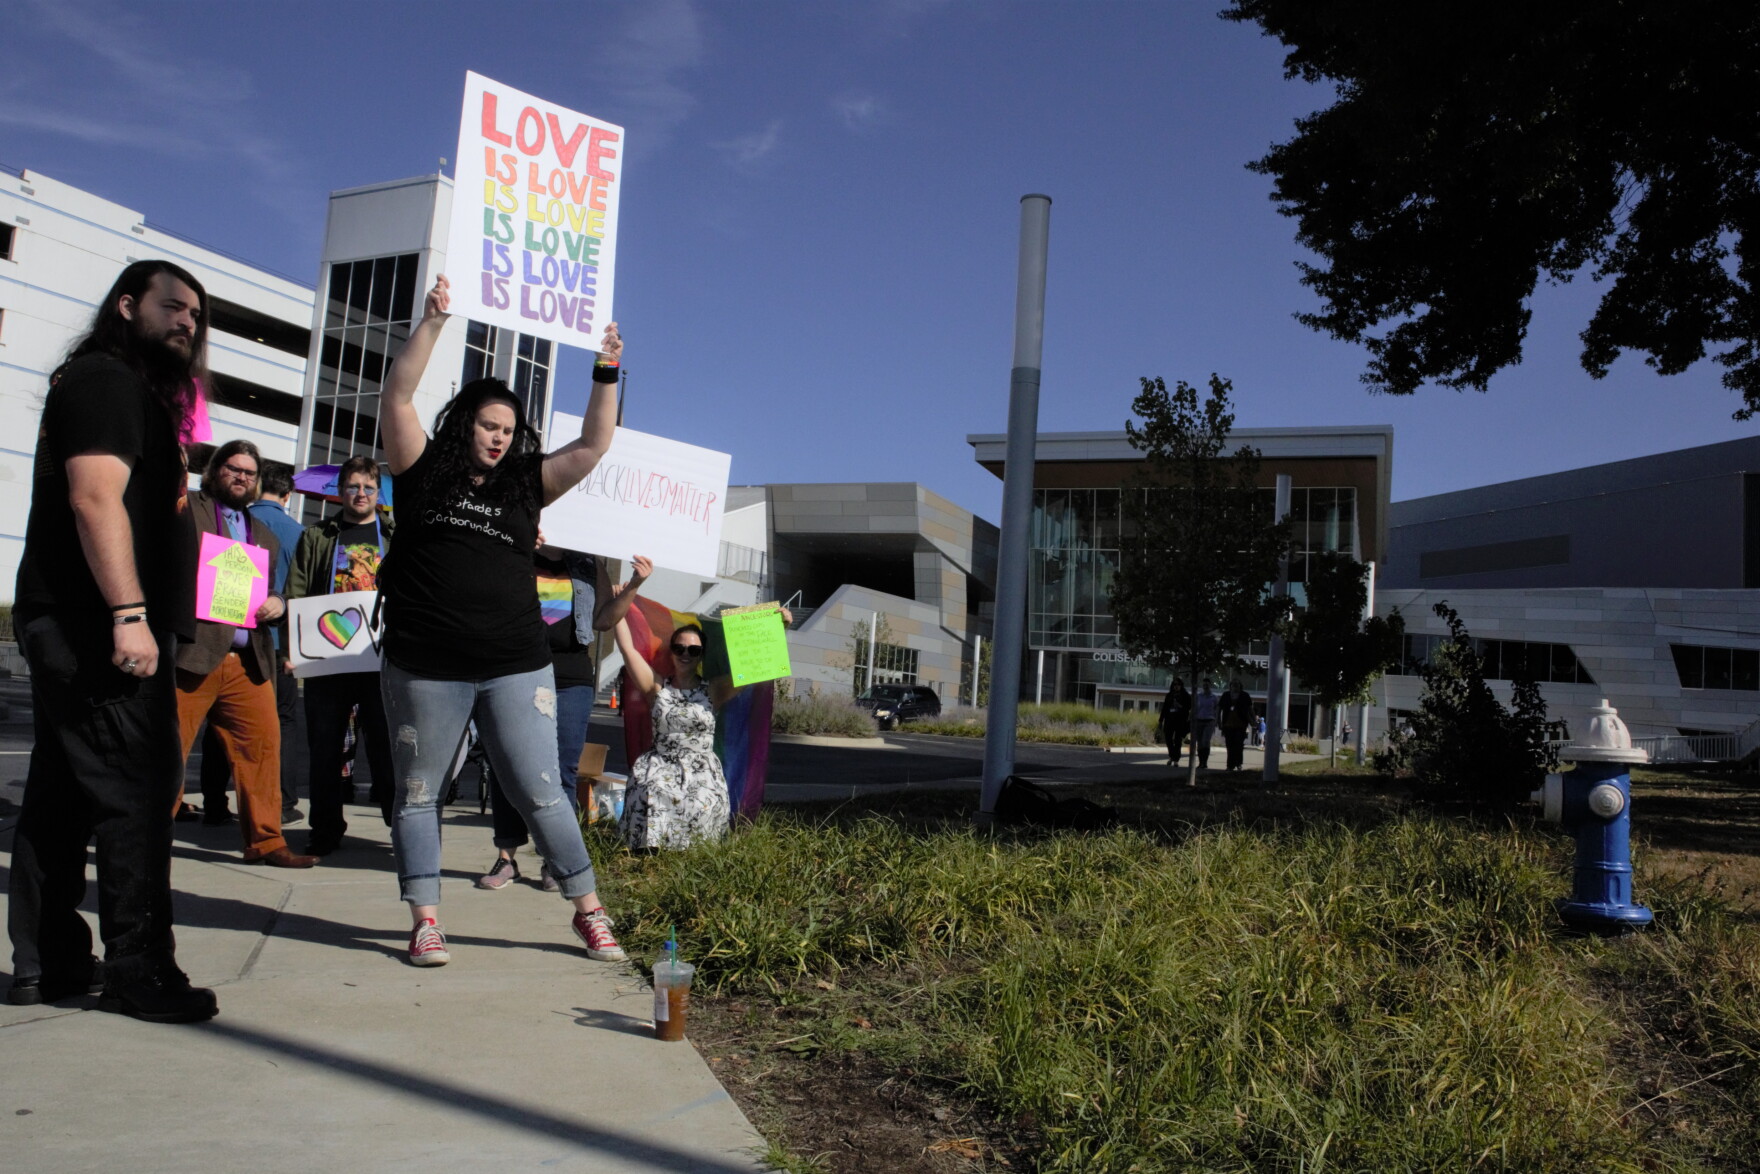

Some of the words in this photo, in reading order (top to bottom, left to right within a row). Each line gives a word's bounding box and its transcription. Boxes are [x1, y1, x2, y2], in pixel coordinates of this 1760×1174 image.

[481, 91, 619, 182] LOVE
[484, 146, 518, 186] IS
[527, 162, 608, 211] LOVE
[483, 207, 515, 244] IS
[524, 220, 601, 266] LOVE
[484, 179, 518, 214] IS
[527, 193, 605, 238] LOVE
[482, 238, 514, 278] IS
[523, 250, 598, 296] LOVE
[481, 271, 510, 310] IS
[520, 284, 595, 334] LOVE
[223, 546, 247, 563] THIS
